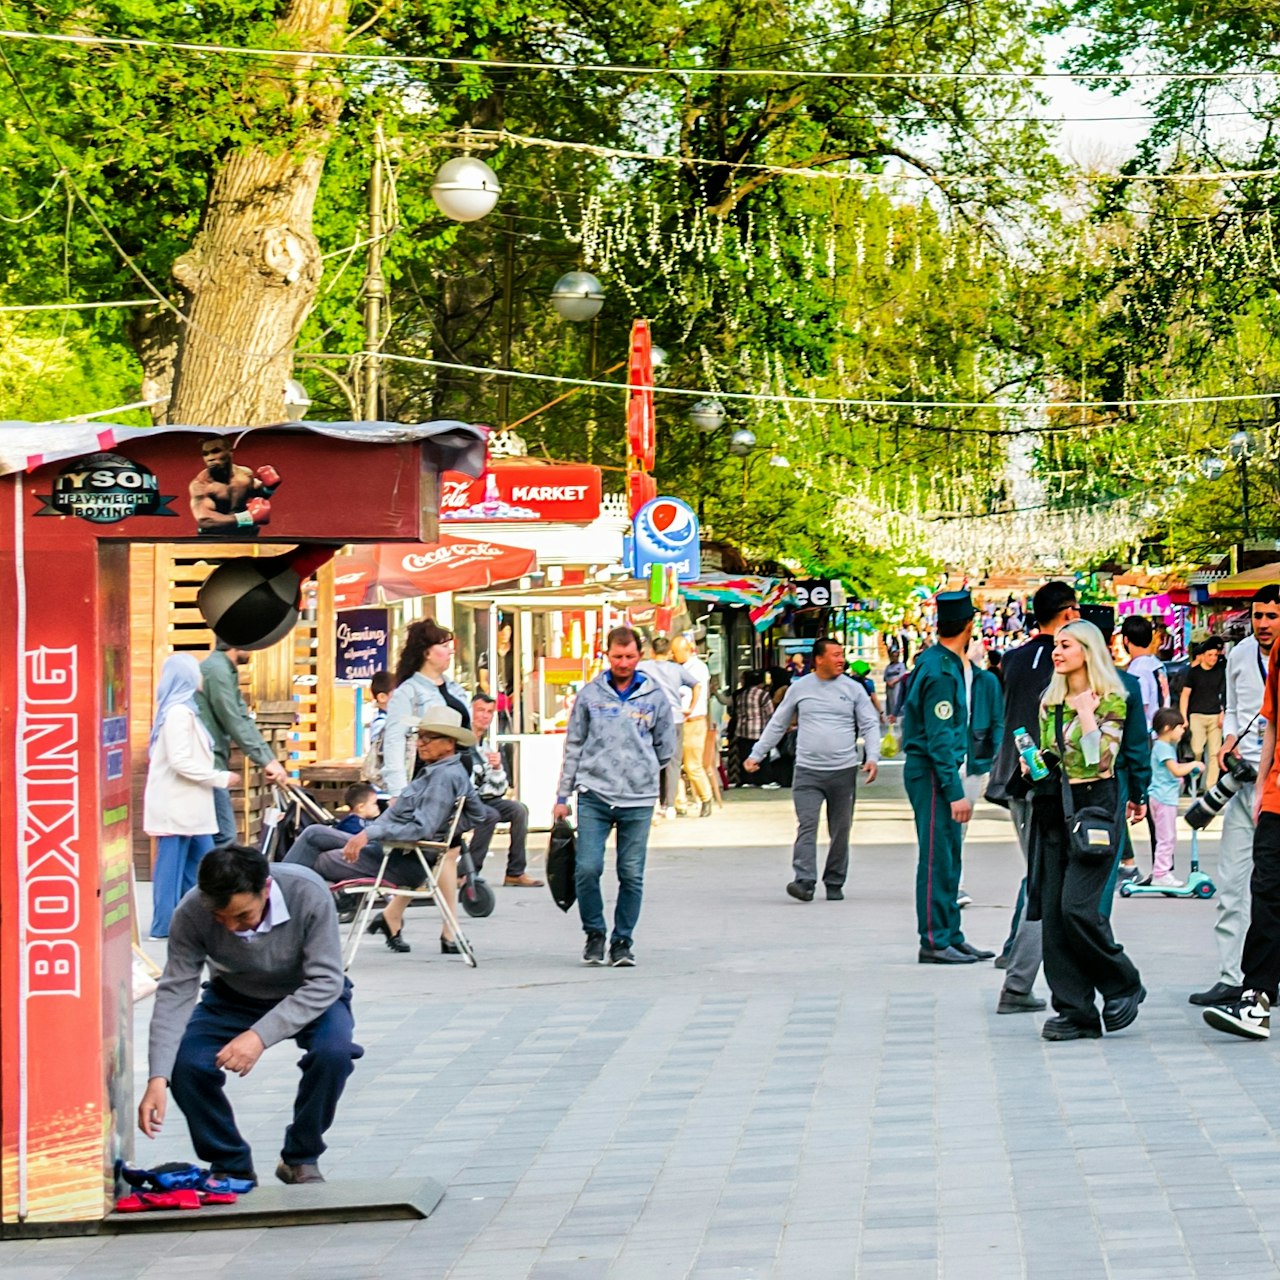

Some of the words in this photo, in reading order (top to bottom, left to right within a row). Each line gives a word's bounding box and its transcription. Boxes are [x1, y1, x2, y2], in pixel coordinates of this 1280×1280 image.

[55, 470, 159, 491] TYSON
[58, 493, 154, 505] HEAVYWEIGHT
[511, 485, 590, 501] MARKET
[73, 506, 136, 518] BOXING
[24, 644, 81, 999] BOXING
